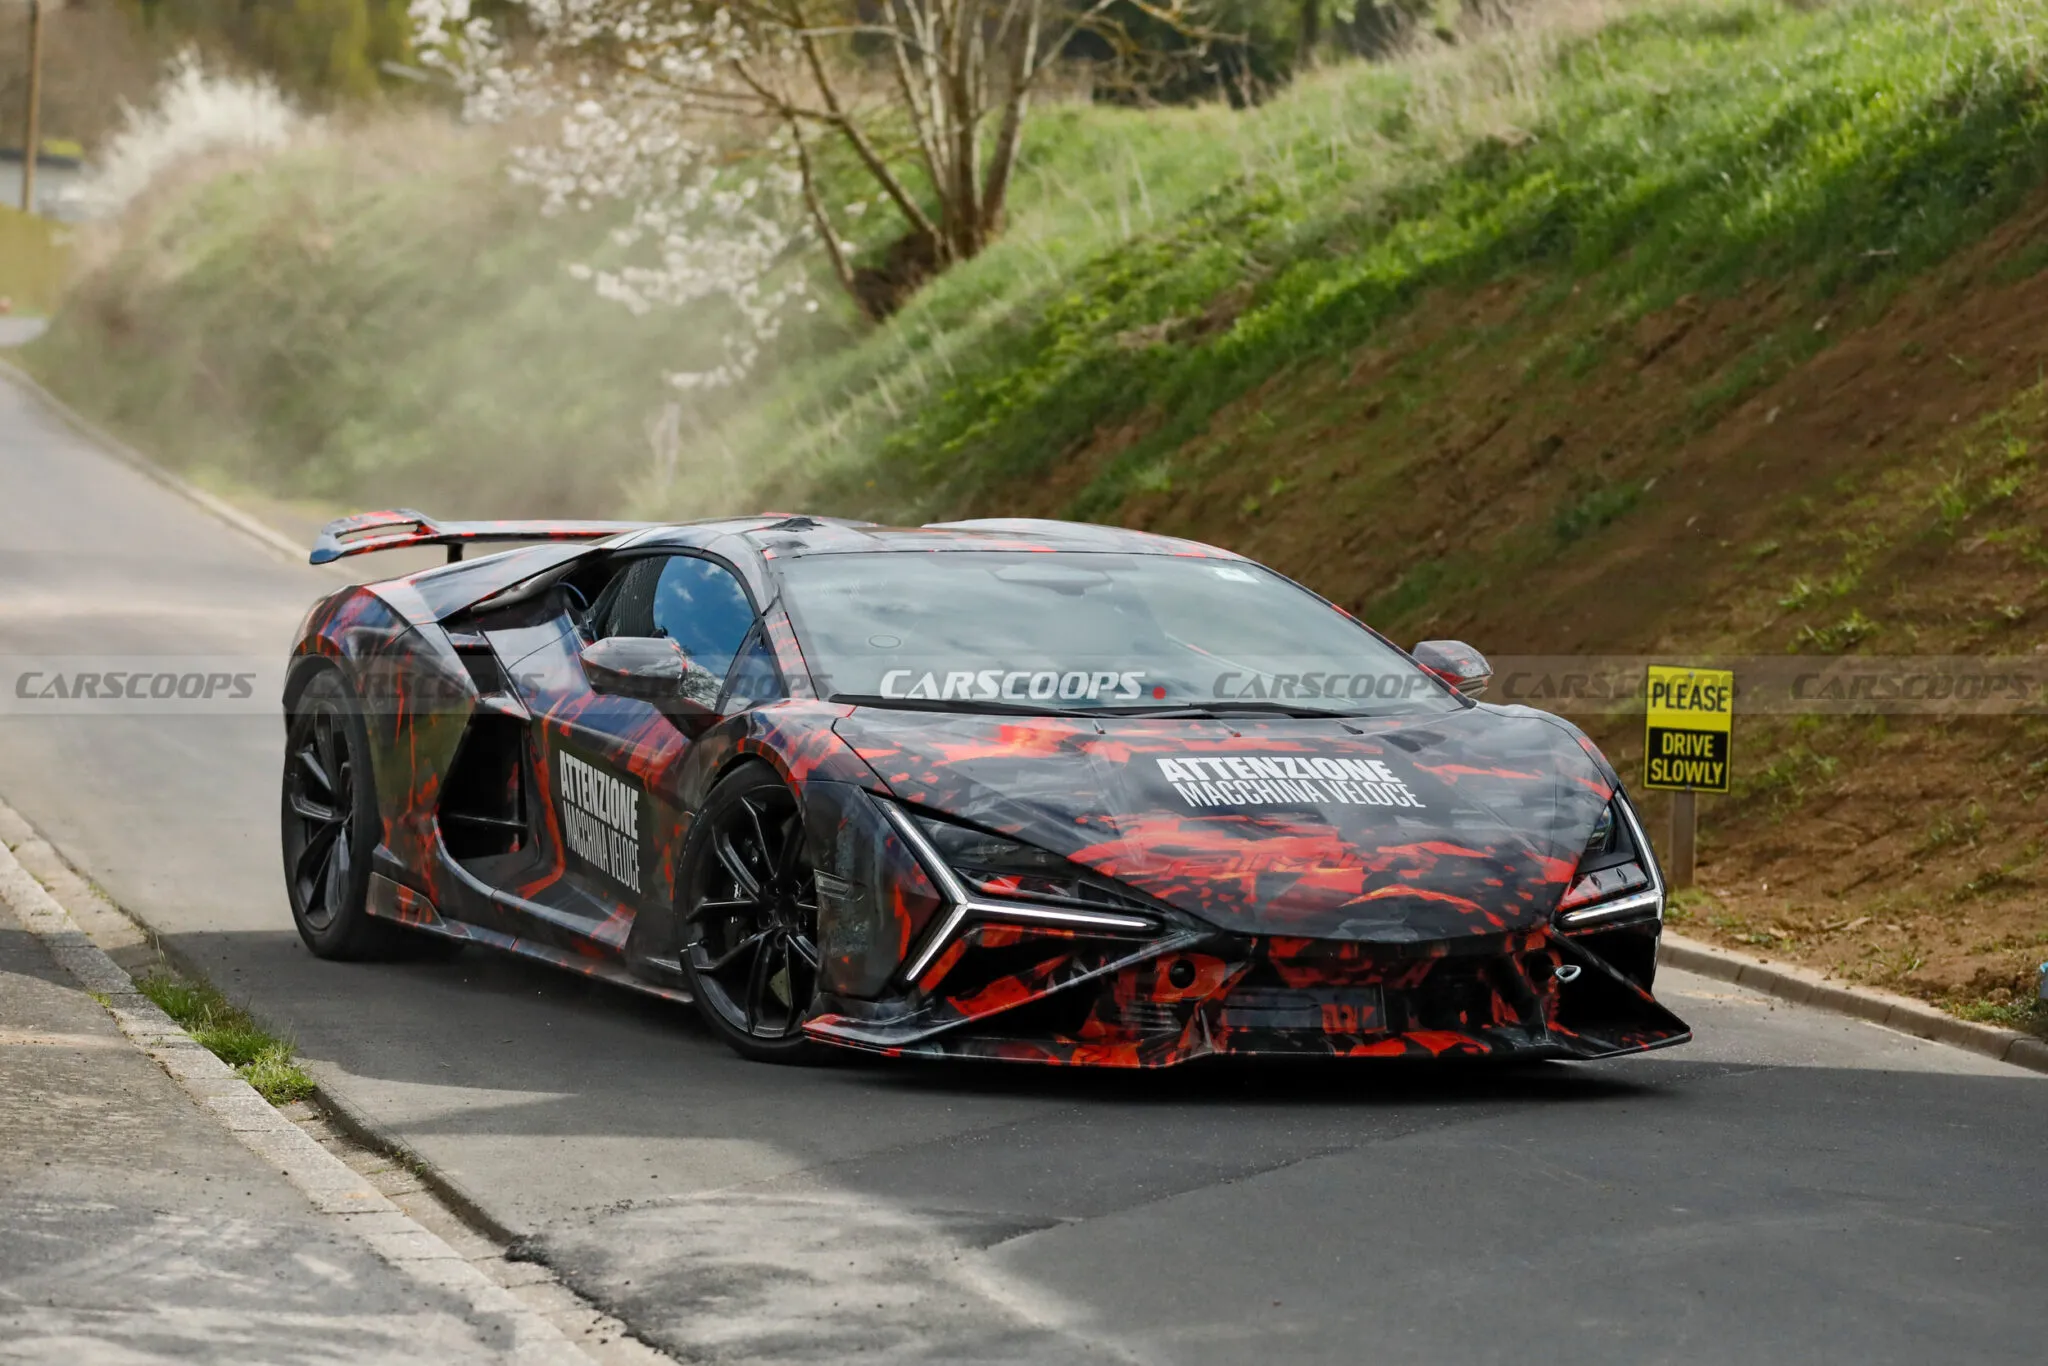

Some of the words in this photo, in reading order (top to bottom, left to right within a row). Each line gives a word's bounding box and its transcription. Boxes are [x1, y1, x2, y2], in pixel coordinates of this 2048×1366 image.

[1652, 682, 1729, 712] PLEASE
[1662, 732, 1715, 757] DRIVE
[1156, 756, 1401, 783] ATTENZIONE
[1650, 758, 1724, 785] SLOWLY
[560, 749, 639, 841] ATTENZIONE
[1173, 779, 1331, 808] MACCHINA
[1321, 780, 1427, 808] VELOCE
[563, 800, 610, 875] MACCHINA
[608, 826, 641, 894] VELOCE
